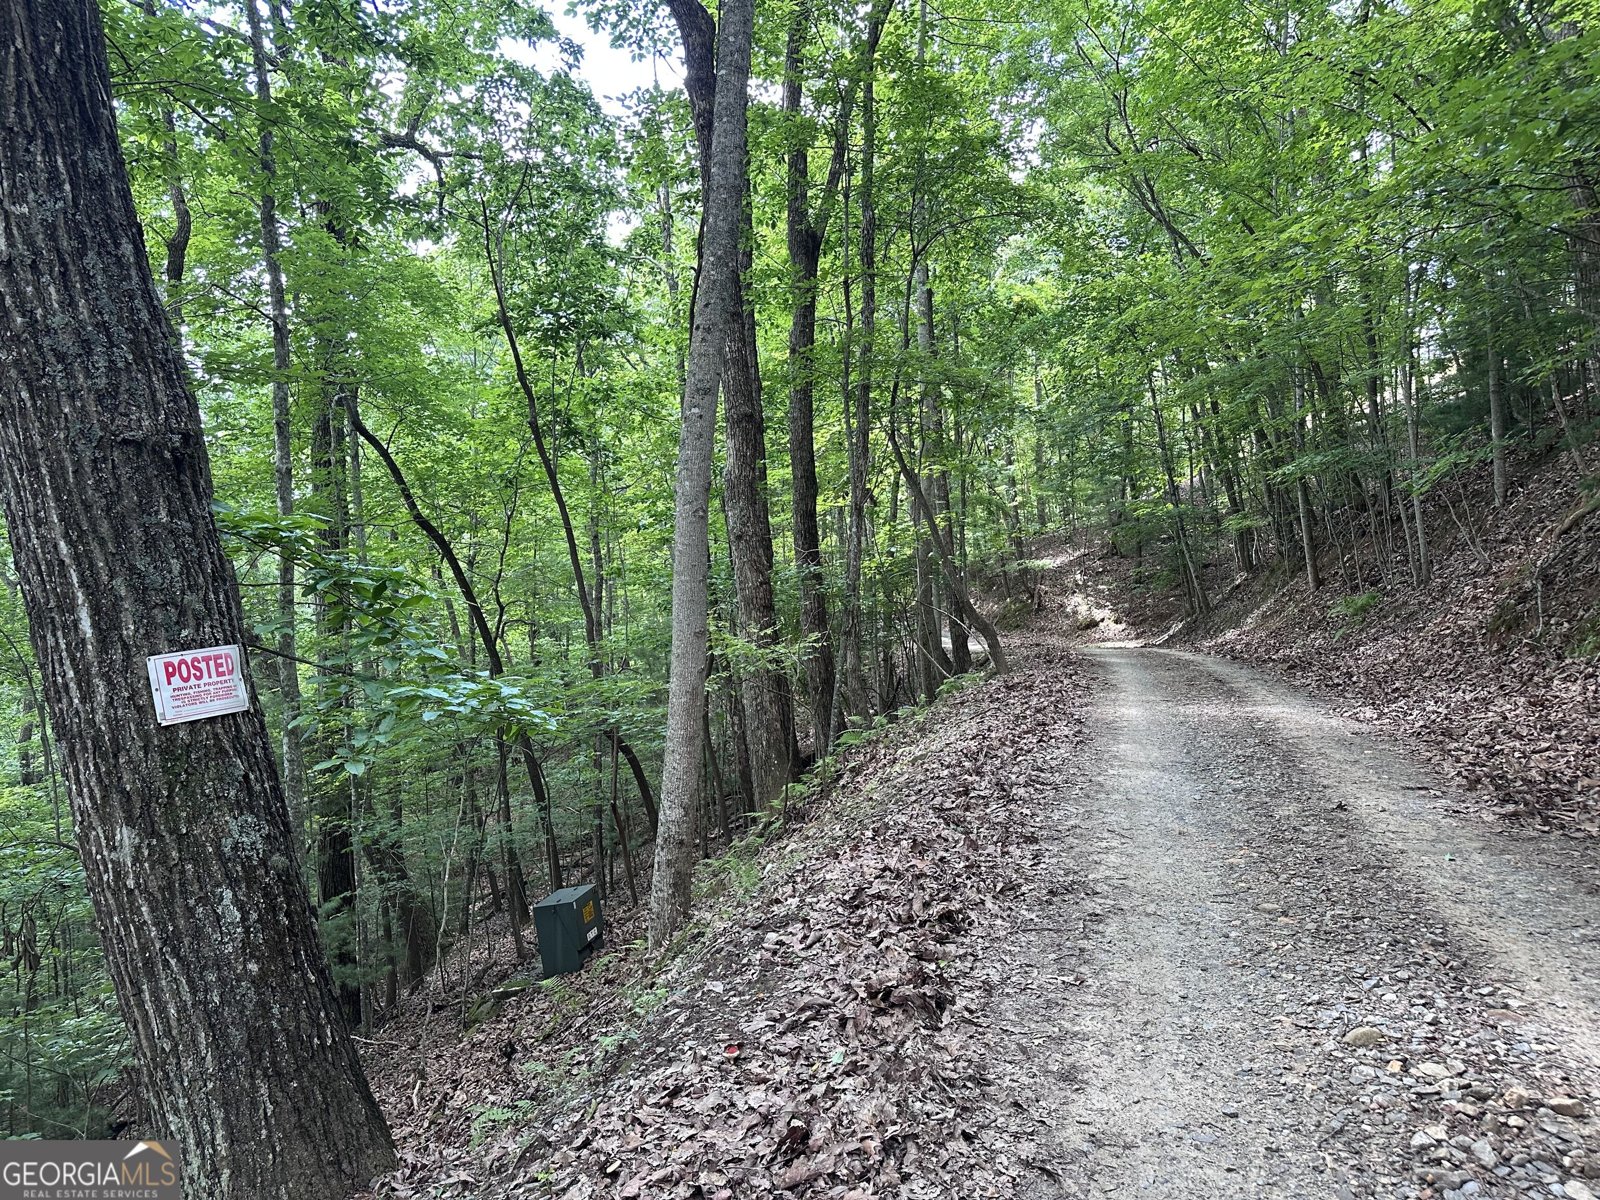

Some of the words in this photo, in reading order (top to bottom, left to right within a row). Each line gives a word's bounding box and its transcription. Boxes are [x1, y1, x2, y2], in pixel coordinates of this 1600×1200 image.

[163, 652, 235, 686] POSTED
[172, 684, 202, 693] PRIVATE
[172, 702, 198, 710] VIOLATORS
